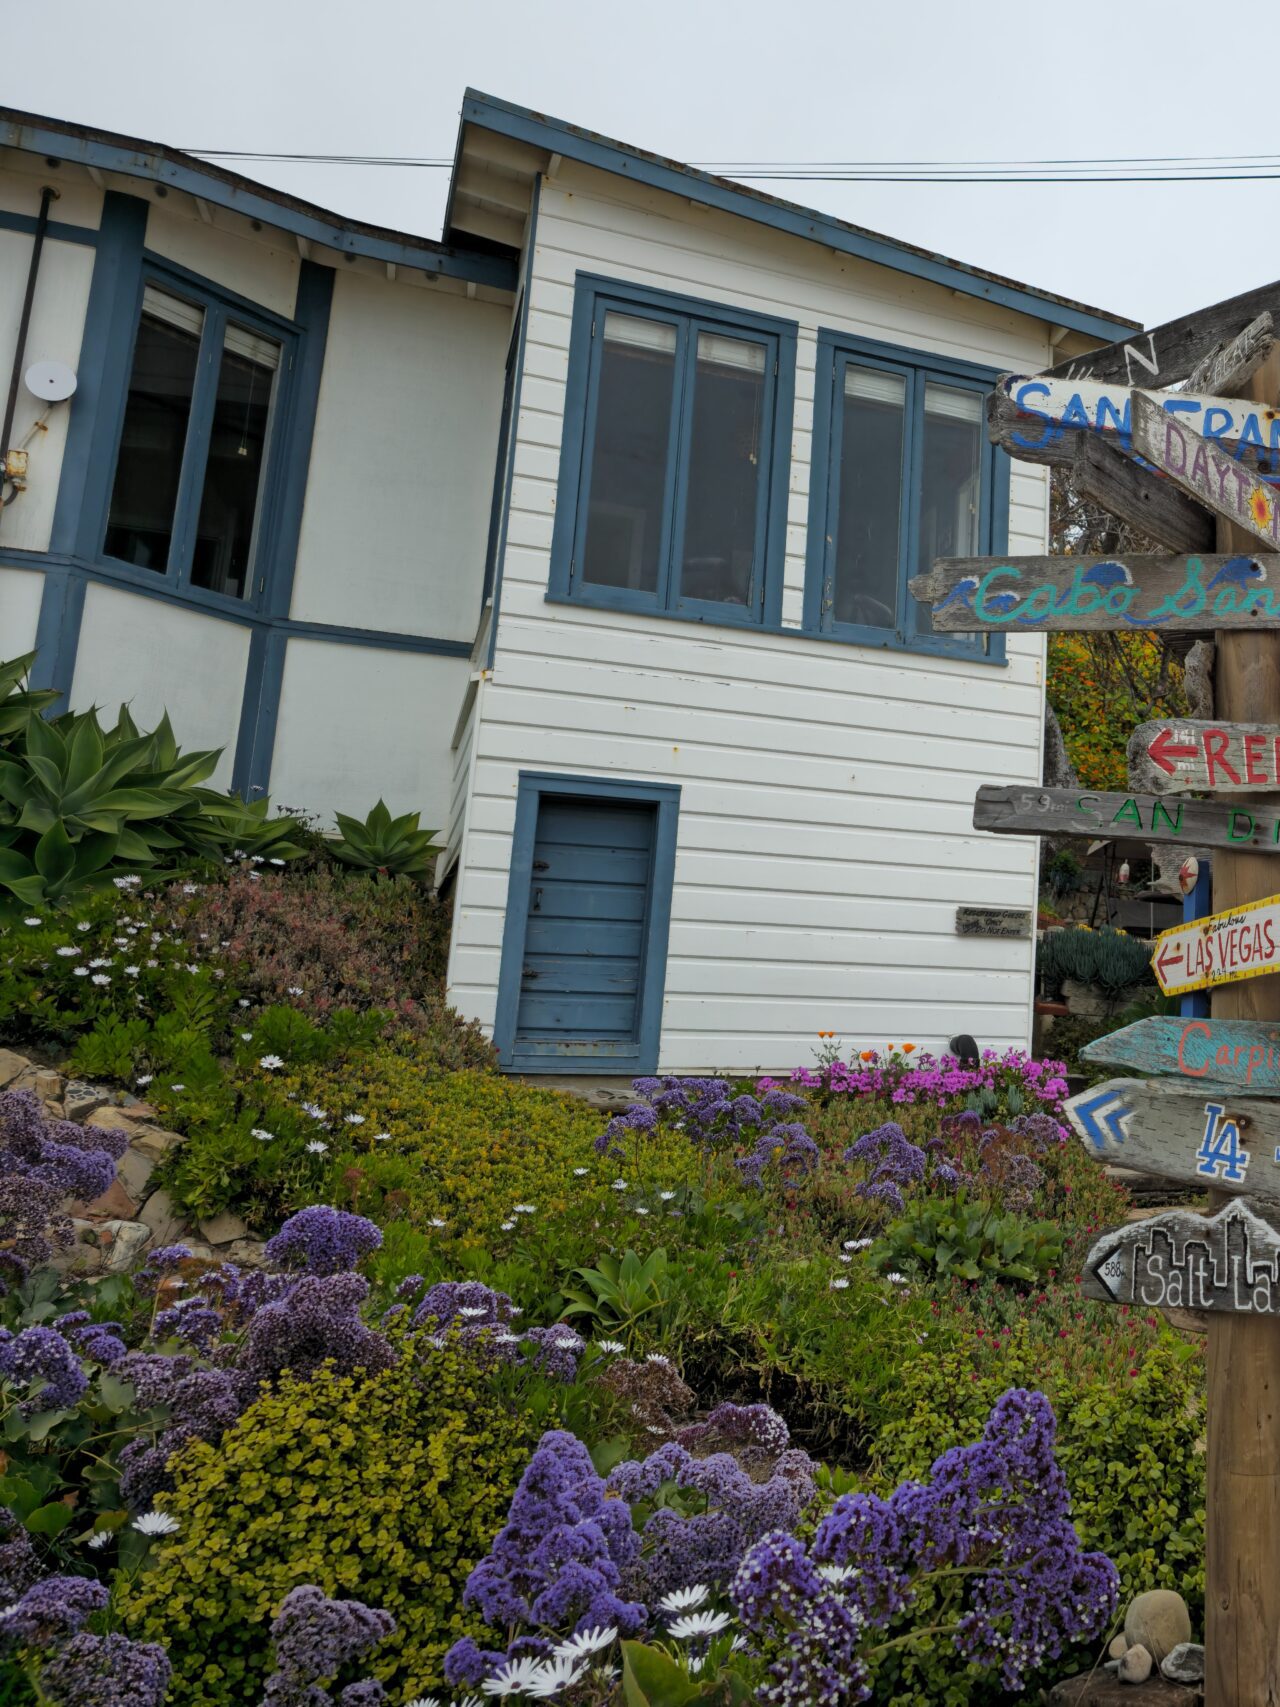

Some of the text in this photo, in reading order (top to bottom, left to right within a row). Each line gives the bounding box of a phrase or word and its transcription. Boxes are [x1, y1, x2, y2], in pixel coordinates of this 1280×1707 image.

[1123, 332, 1159, 387] N
[1010, 382, 1133, 450] SAN
[975, 565, 1141, 624] Cabo
[1071, 793, 1186, 836] SAN
[1186, 918, 1276, 978] LAS VEGAS
[1195, 1101, 1251, 1184] LA
[1141, 1254, 1214, 1308] Salt
